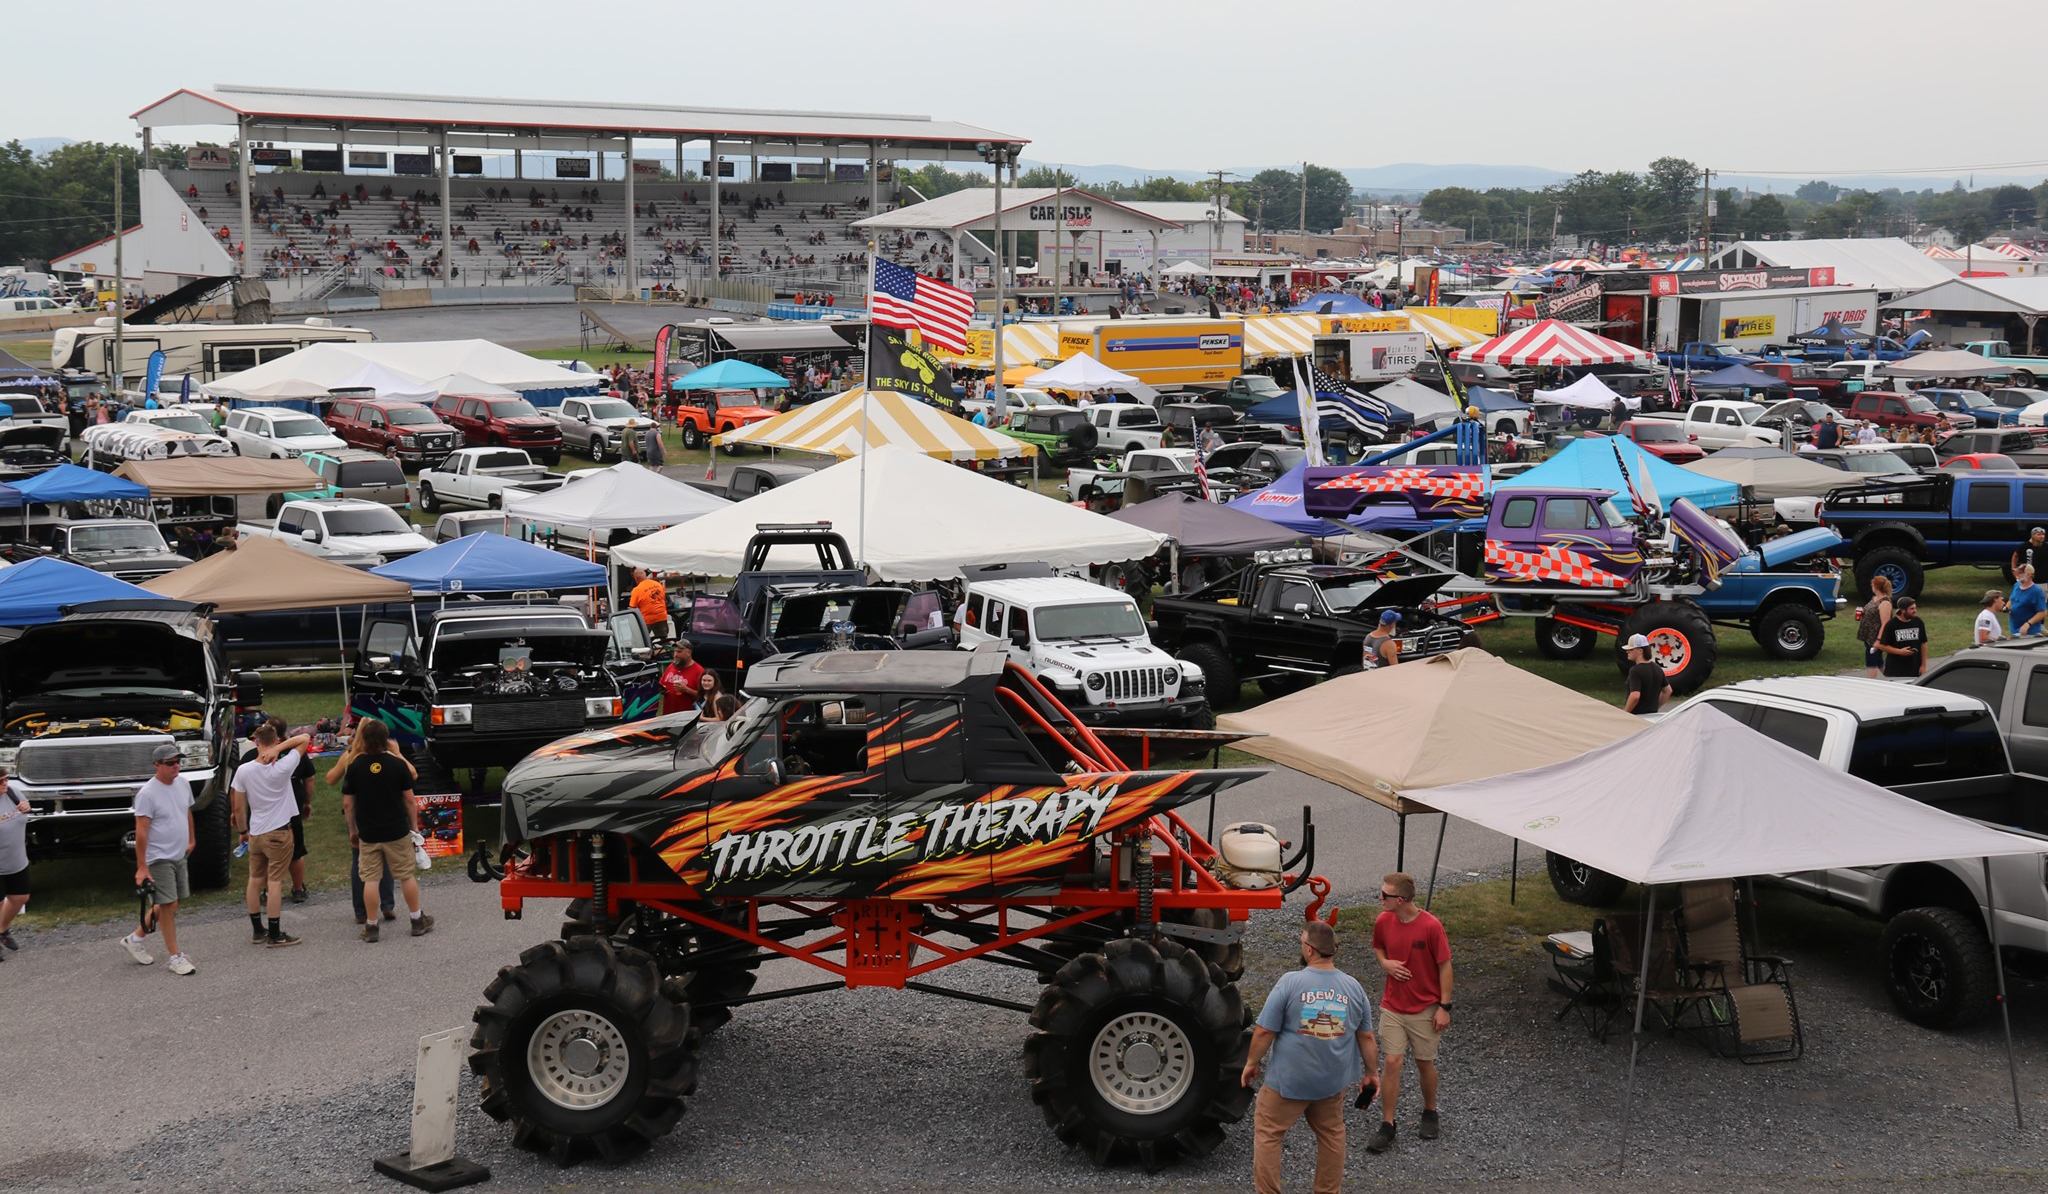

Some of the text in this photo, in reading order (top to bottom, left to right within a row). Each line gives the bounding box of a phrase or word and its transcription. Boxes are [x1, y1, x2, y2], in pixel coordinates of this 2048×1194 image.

[1719, 271, 1768, 292] SKYJACKER
[1549, 282, 1600, 315] SKYJACKER
[1841, 309, 1867, 326] PROS
[1740, 323, 1772, 332] TIRES
[1061, 336, 1092, 346] PENSKE
[1201, 338, 1228, 346] PENSKE
[922, 351, 944, 371] RIDES
[1387, 355, 1417, 365] TIRES
[875, 377, 954, 408] THE SKY IS THE LIMIT
[1896, 633, 1919, 641] FORCE
[1044, 657, 1076, 671] RUBICON
[707, 784, 1120, 886] THROTTLE THERAPY
[1300, 988, 1335, 1005] IBEW
